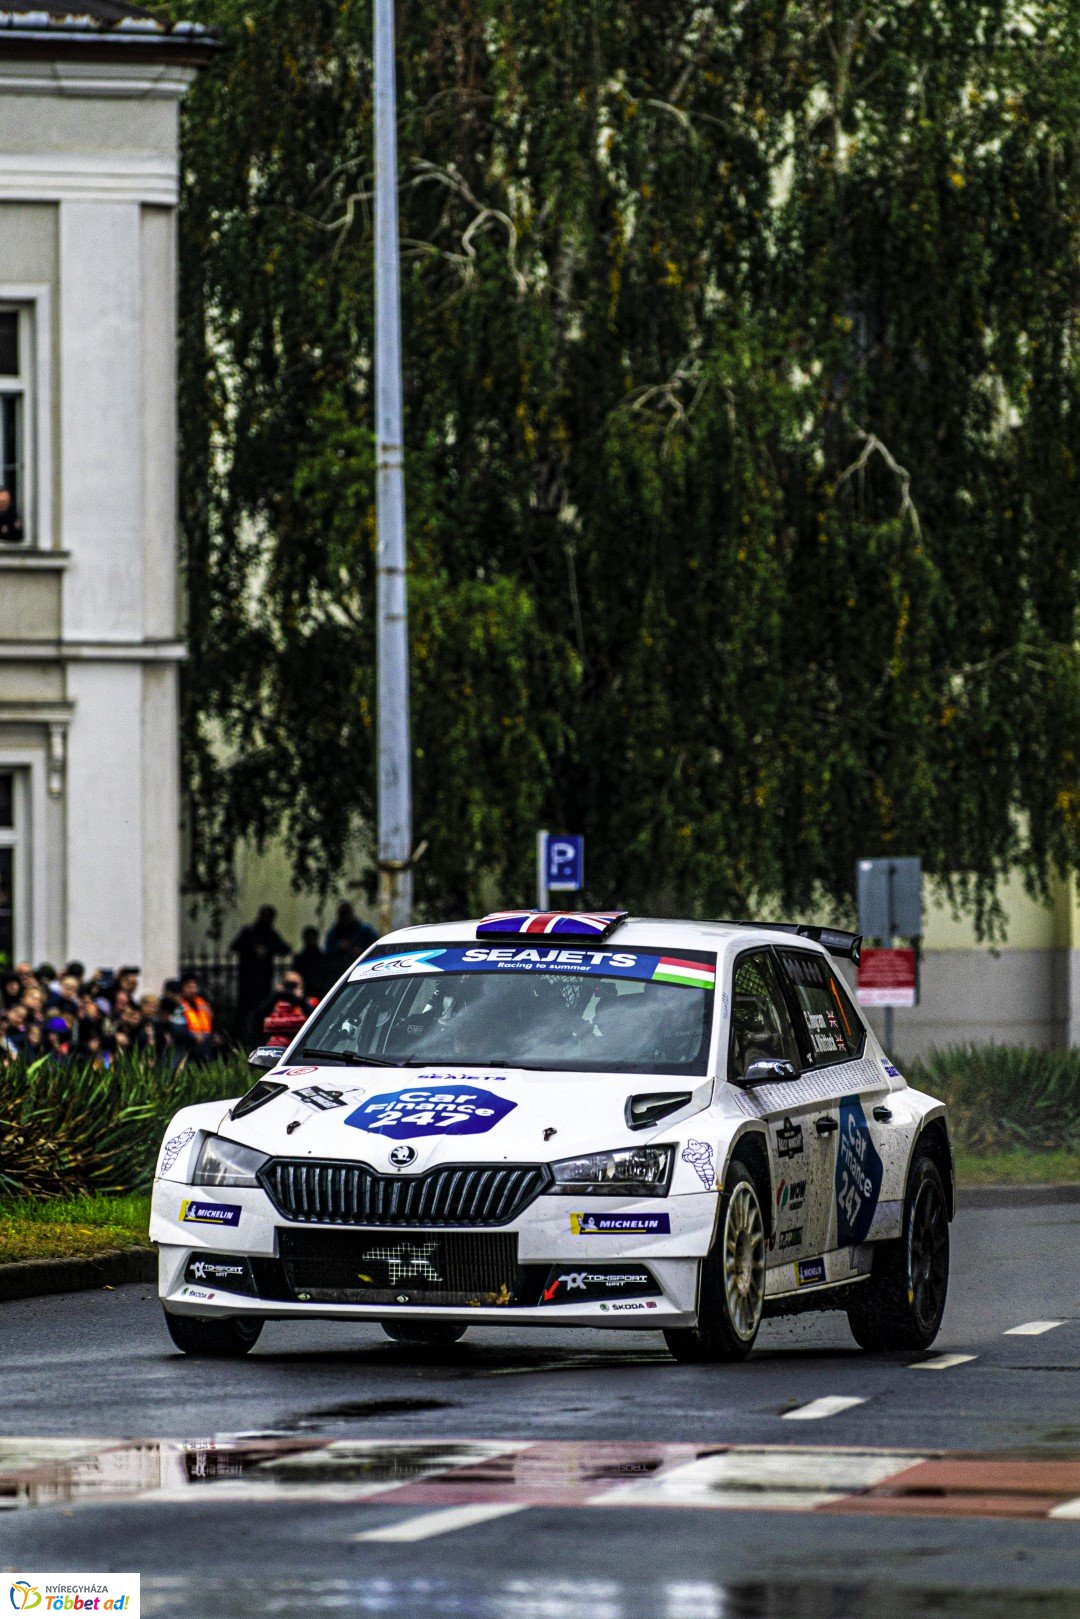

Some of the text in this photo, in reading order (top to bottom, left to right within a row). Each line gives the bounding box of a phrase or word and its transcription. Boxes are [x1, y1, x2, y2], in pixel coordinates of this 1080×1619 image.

[551, 842, 575, 875] P
[461, 948, 638, 968] SEAJETS
[497, 962, 532, 970] Racing
[398, 1091, 478, 1104] Car
[363, 1101, 495, 1117] Finance
[368, 1110, 471, 1129] 247
[848, 1113, 867, 1162] Car
[841, 1134, 873, 1198] Finance
[838, 1170, 862, 1227] 247
[196, 1209, 234, 1220] MICHELIN
[599, 1220, 659, 1228] MICHELIN
